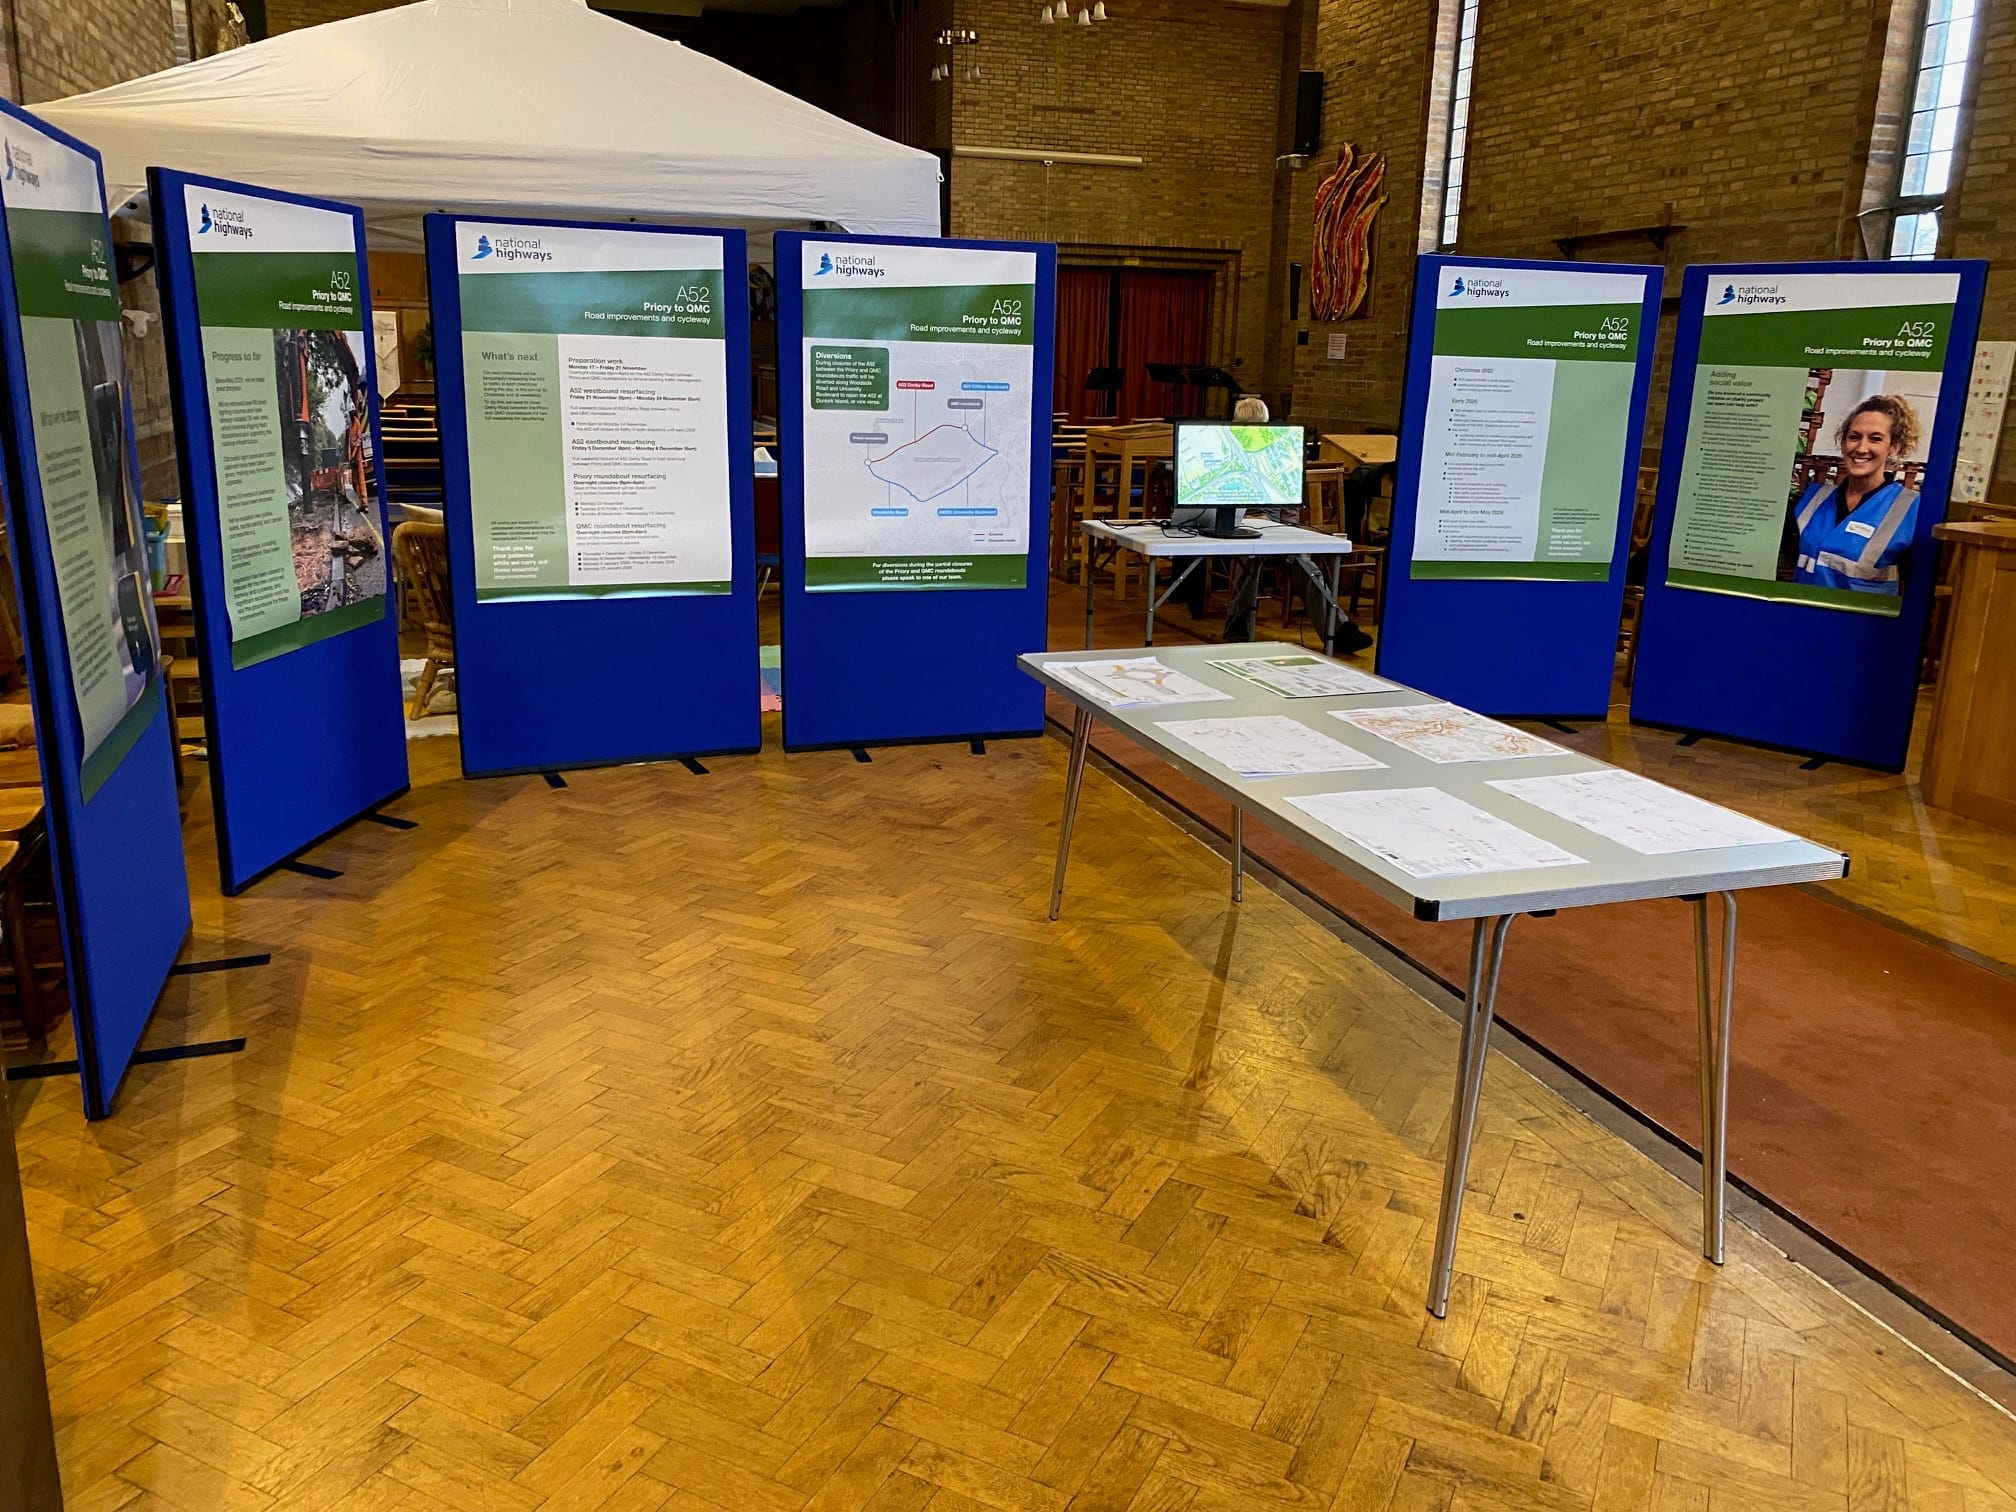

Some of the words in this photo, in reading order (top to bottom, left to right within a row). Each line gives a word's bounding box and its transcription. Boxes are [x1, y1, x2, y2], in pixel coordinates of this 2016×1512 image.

[213, 208, 244, 222] national
[214, 221, 253, 239] highways
[496, 238, 541, 249] national
[496, 248, 552, 262] highways
[836, 256, 875, 265] national
[836, 265, 884, 278] highways
[331, 270, 350, 290] A52
[1468, 279, 1502, 288] national
[312, 290, 330, 302] Priory
[330, 290, 336, 300] to
[338, 291, 352, 302] QMC
[676, 286, 710, 302] A52
[1467, 287, 1510, 298] highways
[1738, 286, 1778, 294] national
[1738, 294, 1786, 305] highways
[644, 302, 672, 314] Priory
[674, 303, 684, 312] to
[686, 304, 710, 314] QMC
[992, 300, 1022, 315] A52
[584, 311, 604, 320] Road
[606, 312, 659, 322] improvements
[661, 314, 675, 322] and
[677, 314, 710, 324] cycleway
[962, 316, 988, 325] Priory
[990, 316, 998, 324] to
[1000, 317, 1022, 326] QMC
[910, 324, 928, 332] Road
[930, 324, 976, 334] improvements
[978, 326, 990, 334] and
[992, 327, 1022, 336] cycleway
[1600, 317, 1628, 332] A52
[1898, 322, 1935, 338] A52
[1574, 331, 1596, 340] Priory
[1608, 332, 1628, 340] QMC
[1544, 340, 1585, 348] improvements
[1599, 342, 1626, 350] cycleway
[1862, 338, 1892, 348] Priory
[1894, 338, 1904, 346] to
[1906, 338, 1934, 348] QMC
[212, 351, 242, 363] Progress
[253, 352, 262, 361] far
[482, 352, 514, 360] What's
[1804, 346, 1824, 354] Road
[1825, 348, 1878, 357] improvements
[1878, 349, 1893, 357] and
[1895, 350, 1931, 358] cycleway
[1711, 371, 1736, 379] Adding
